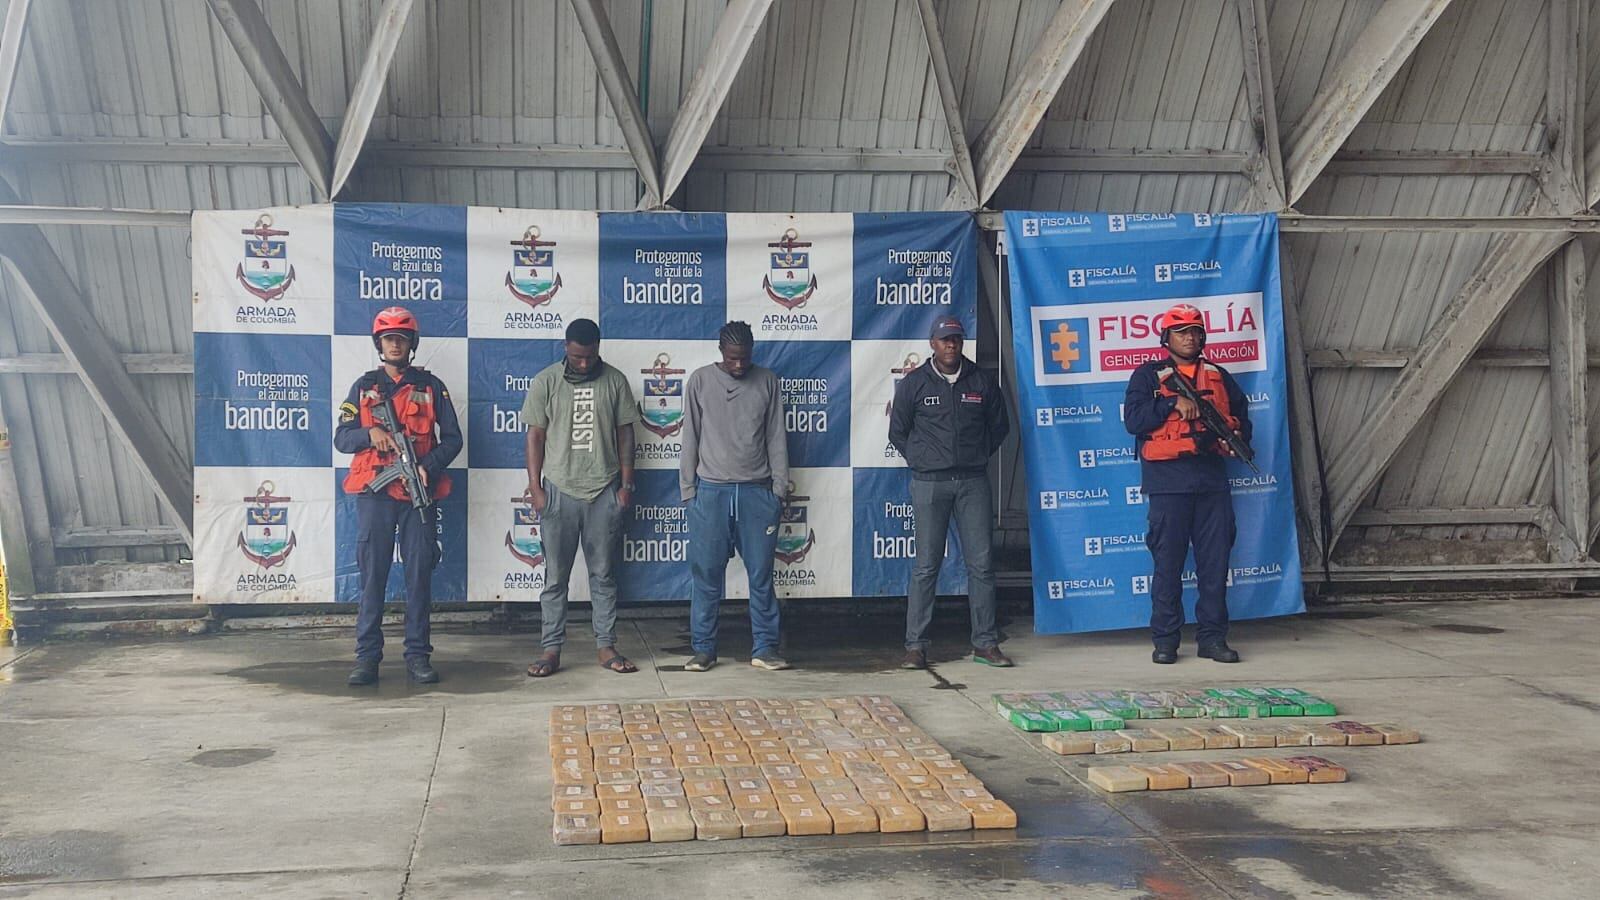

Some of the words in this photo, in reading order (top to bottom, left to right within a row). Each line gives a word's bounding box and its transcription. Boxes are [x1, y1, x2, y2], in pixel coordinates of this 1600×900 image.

[1040, 214, 1092, 226] FISCALÍA
[372, 241, 442, 261] Protegemos
[635, 248, 702, 266] Protegemos
[888, 248, 952, 266] Protegemos
[393, 260, 400, 272] el
[402, 260, 420, 272] azul
[422, 260, 432, 272] de
[434, 260, 442, 273] la
[655, 265, 662, 278] el
[664, 265, 681, 278] azul
[682, 266, 693, 278] de
[694, 265, 702, 278] la
[907, 265, 914, 277] el
[915, 265, 932, 277] azul
[933, 264, 943, 277] de
[944, 265, 952, 277] la
[1086, 264, 1136, 278] FISCALÍA
[1172, 260, 1222, 272] FISCALÍA
[360, 270, 442, 301] bandera
[623, 276, 702, 304] bandera
[876, 276, 952, 305] bandera
[236, 306, 297, 317] ARMADA
[504, 312, 562, 322] ARMADA
[762, 314, 818, 324] ARMADA
[1210, 342, 1254, 360] NACIÓN
[238, 369, 308, 390] Protegemos
[780, 376, 828, 394] tegemos
[258, 388, 266, 401] el
[268, 388, 286, 401] azul
[288, 388, 299, 401] de
[300, 388, 309, 401] la
[782, 392, 788, 404] el
[790, 392, 806, 404] azul
[808, 392, 818, 404] de
[820, 392, 828, 404] la
[924, 396, 940, 406] CTI
[224, 400, 309, 430] bandera
[1054, 404, 1102, 416] FISCALÍA
[571, 388, 594, 453] RESIST
[786, 405, 828, 432] dera
[636, 443, 682, 452] ARMAD
[1096, 448, 1135, 458] FISCAL
[1058, 487, 1108, 500] FISCALÍA
[654, 521, 662, 534] el
[664, 521, 680, 534] azul
[1103, 532, 1144, 546] FISCALÍ
[624, 534, 690, 562] bander
[772, 570, 816, 580] RMADA
[1234, 563, 1282, 577] FISCALÍA
[237, 574, 296, 584] ARMADA
[504, 572, 543, 582] ARMA
[1064, 577, 1114, 590] FISCALÍA
